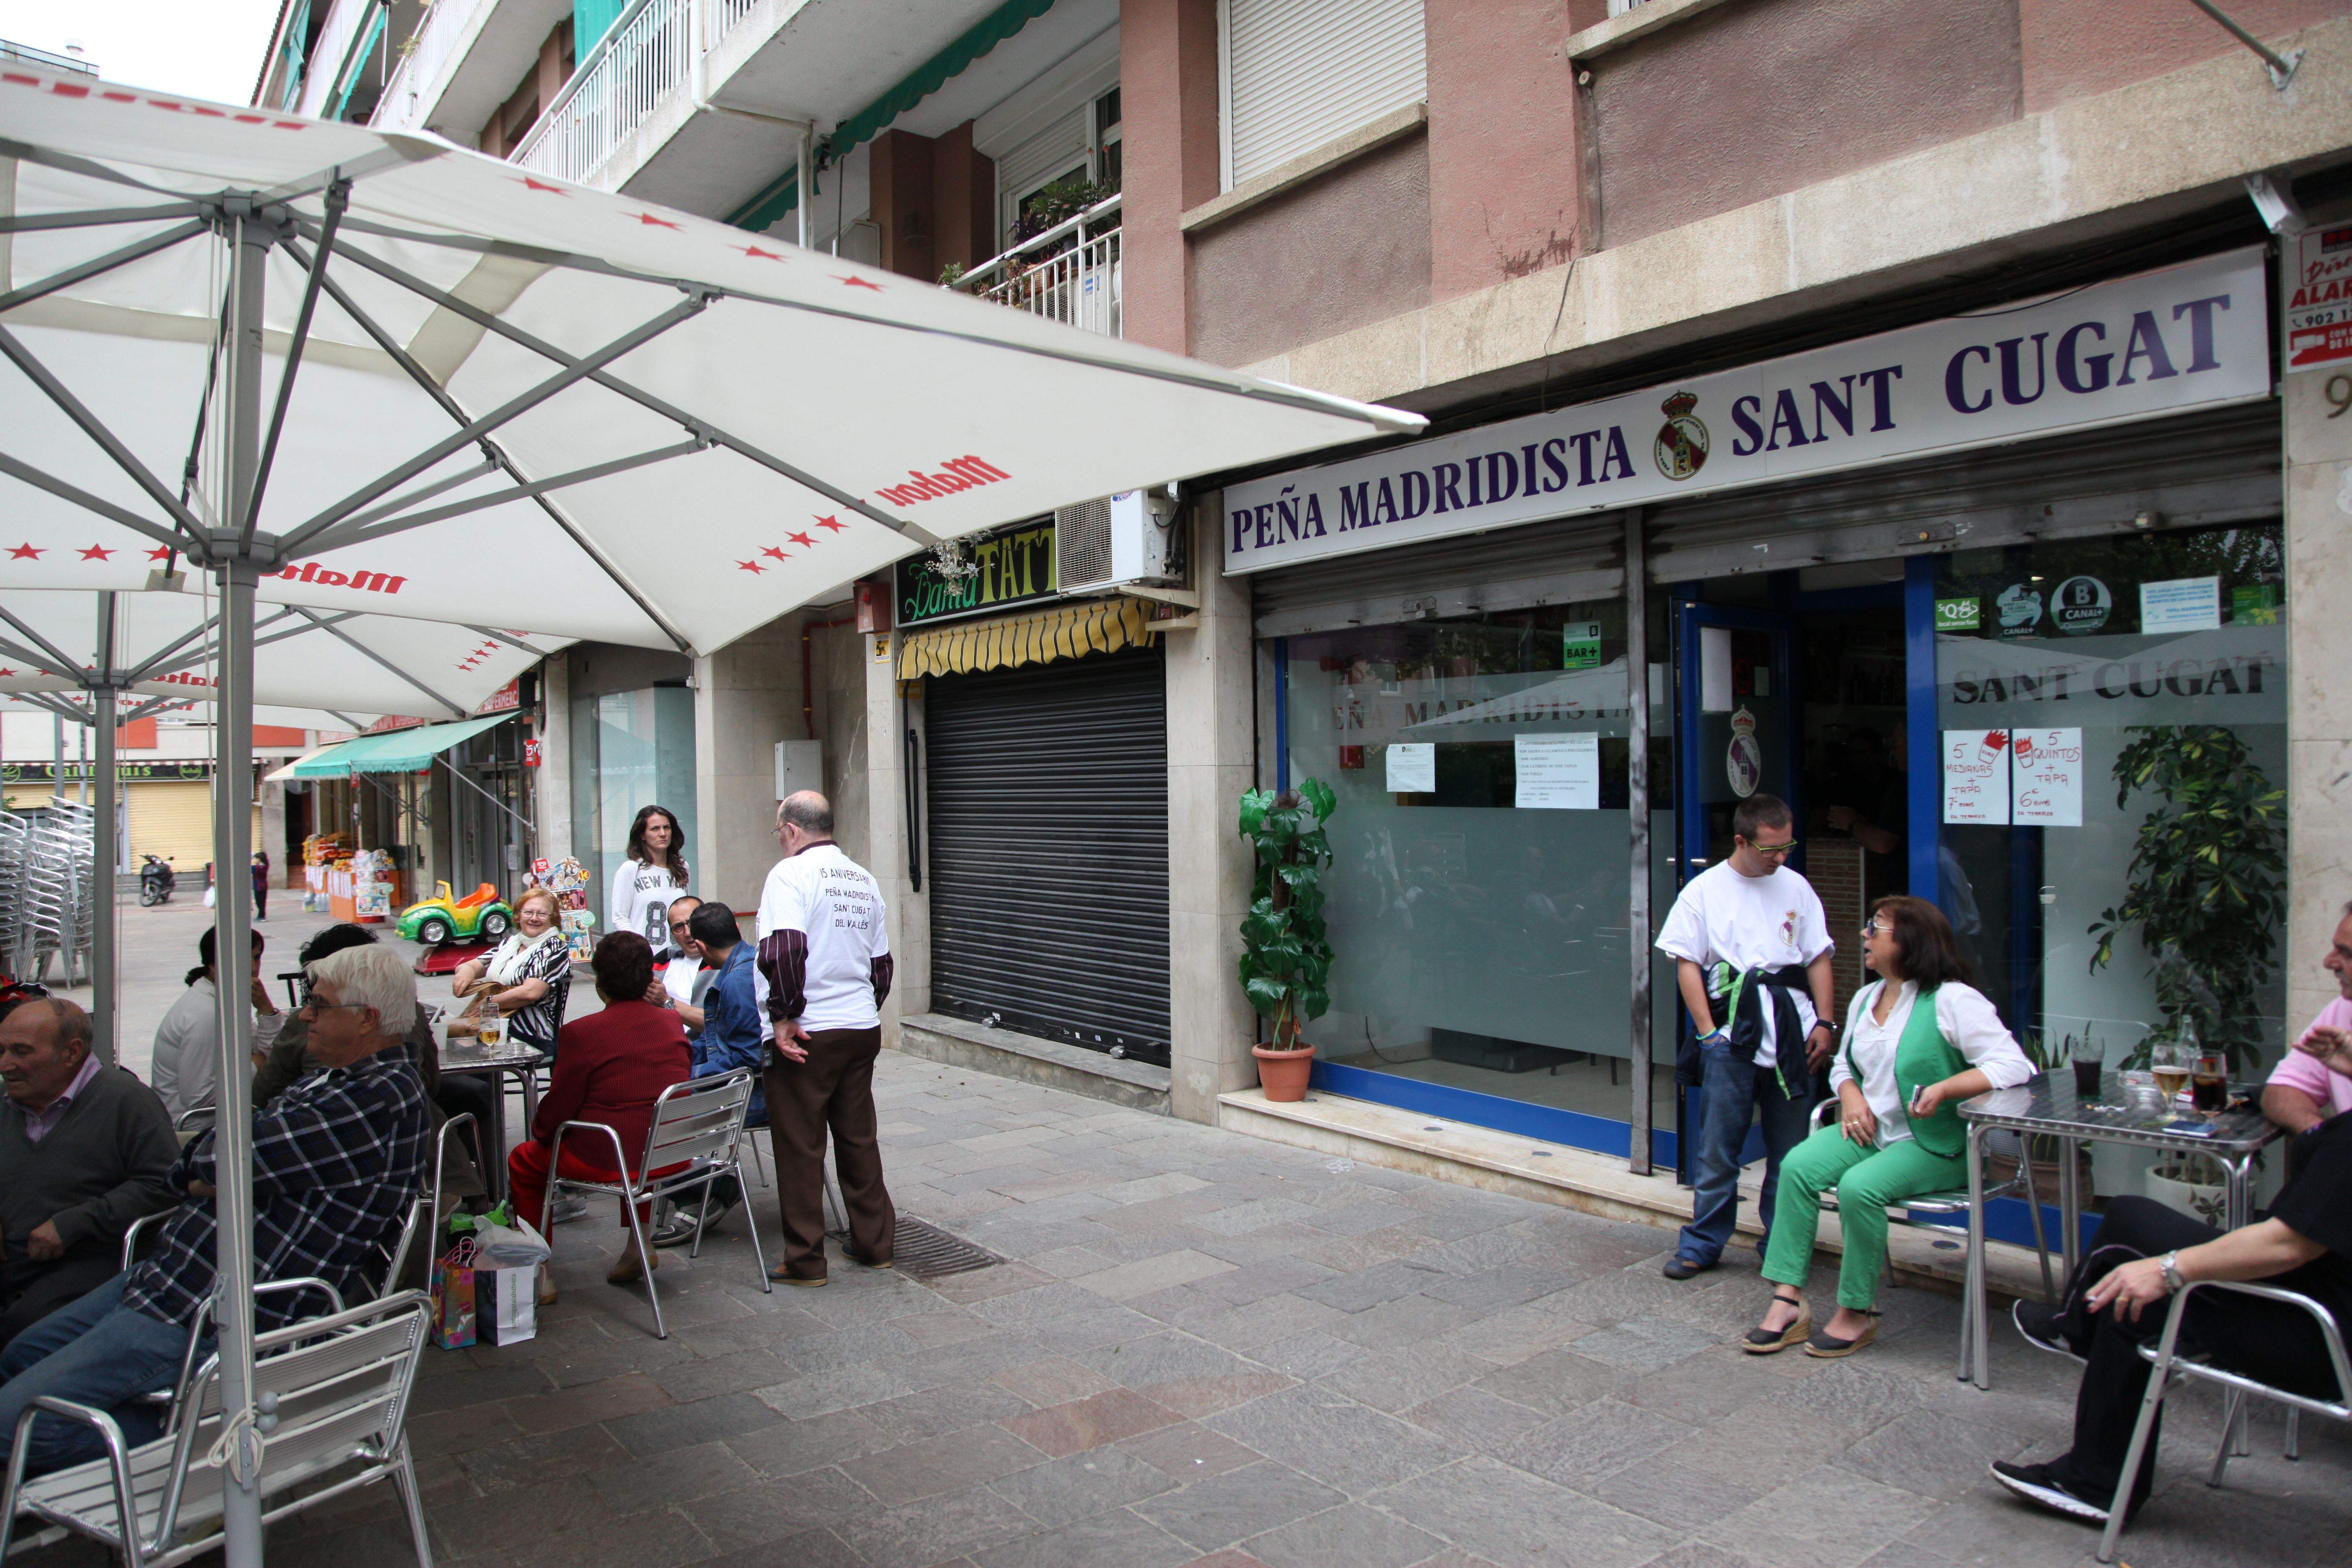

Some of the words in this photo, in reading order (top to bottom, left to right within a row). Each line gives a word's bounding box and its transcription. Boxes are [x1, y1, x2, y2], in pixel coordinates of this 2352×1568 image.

[2306, 312, 2333, 326] 902
[1231, 484, 1327, 553] PEÑA
[1339, 425, 1636, 533] MADRIDISTA
[1731, 365, 1903, 456] SANT
[1944, 293, 2231, 415] CUGAT
[2076, 585, 2091, 604] B
[2065, 608, 2103, 620] CANAL+
[1953, 667, 2079, 704] SANT
[2094, 655, 2275, 699] CUGAT
[2048, 732, 2062, 745] 5
[1954, 743, 1968, 758] 5
[2034, 747, 2081, 762] QUINTOS
[1946, 764, 1994, 777] MEDIANAS
[2035, 774, 2068, 787] TAPA
[1951, 786, 1981, 794] TAPA
[819, 868, 828, 878] 15
[634, 875, 661, 893] NEW
[825, 887, 842, 897] PEÑA
[843, 890, 874, 902] MADRIDISTA
[834, 904, 850, 913] SANT
[851, 905, 871, 916] CUGAT
[835, 919, 845, 928] DEL
[848, 920, 869, 930] VALLÉS
